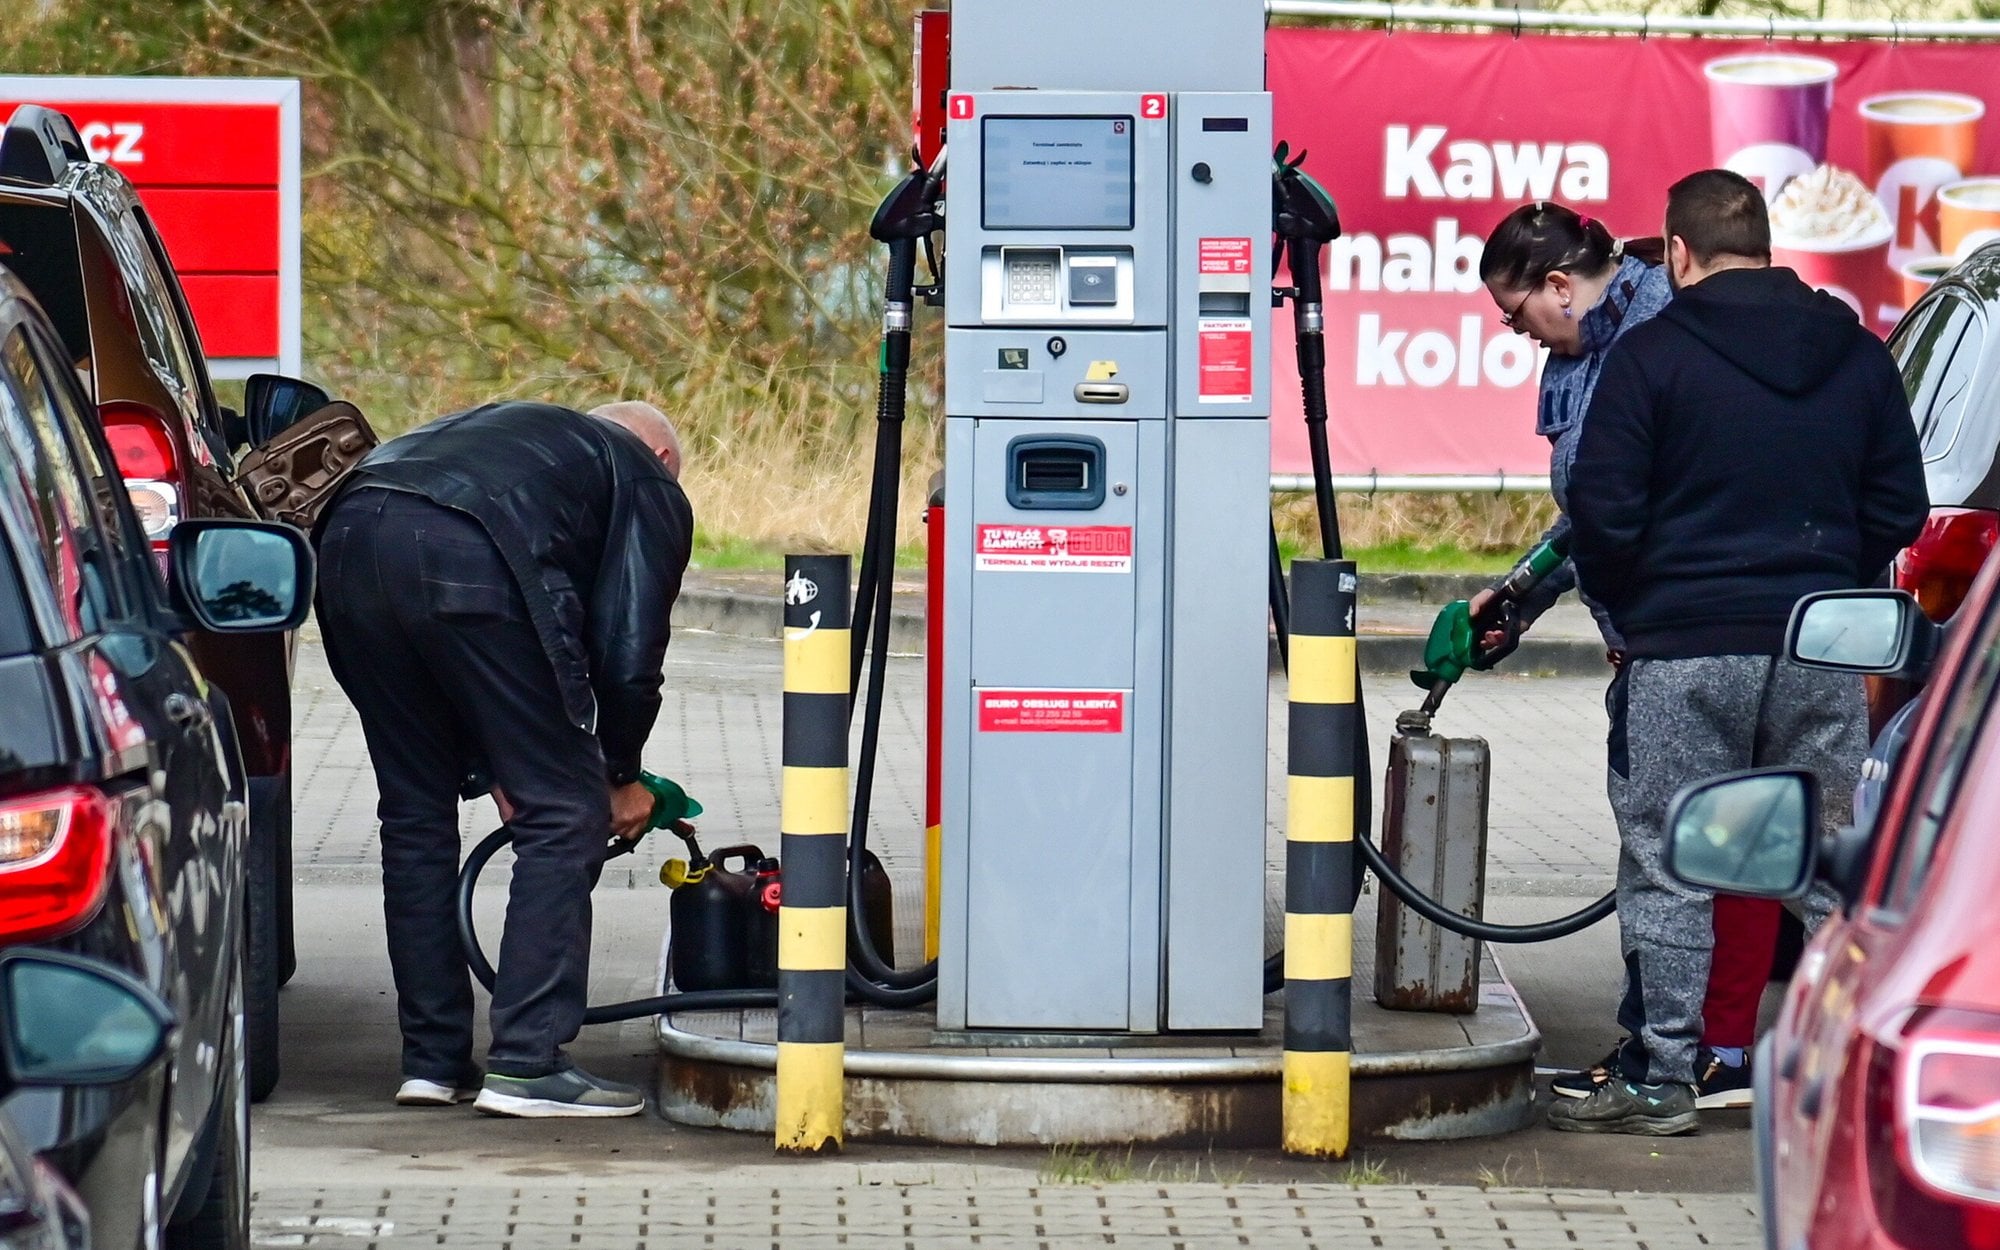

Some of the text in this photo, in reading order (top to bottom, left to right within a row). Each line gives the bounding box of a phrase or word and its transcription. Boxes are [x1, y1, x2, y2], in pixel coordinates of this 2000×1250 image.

[956, 99, 966, 115] 1
[1146, 98, 1160, 115] 2
[1384, 125, 1609, 200] Kawa
[1329, 218, 1486, 293] nab
[984, 529, 1001, 539] TU
[984, 540, 1044, 549] BANKNOT
[983, 558, 1028, 566] TERMINAL
[985, 699, 1019, 708] BIURO
[1072, 699, 1118, 708] KLIENTA
